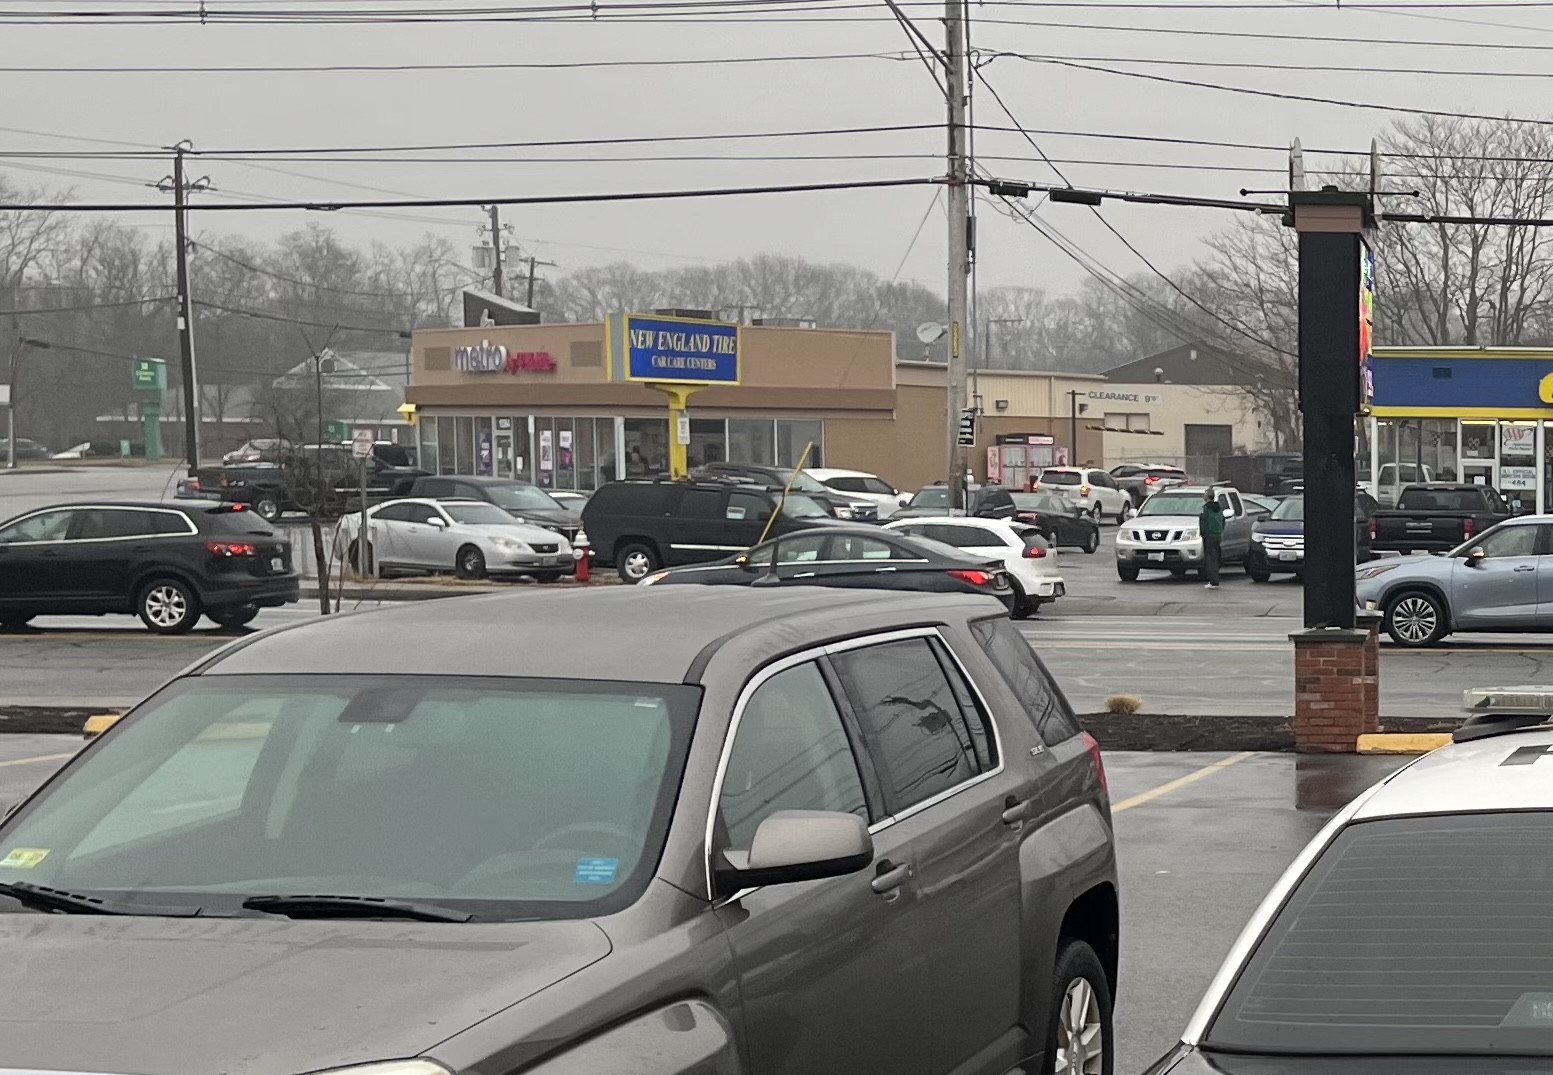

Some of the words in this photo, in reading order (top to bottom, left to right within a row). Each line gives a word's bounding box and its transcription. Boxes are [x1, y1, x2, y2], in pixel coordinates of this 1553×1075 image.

[629, 329, 656, 349] NEW
[658, 331, 711, 352] ENGLAND
[712, 335, 737, 354] TIRE
[1088, 391, 1139, 402] CLEARANCE
